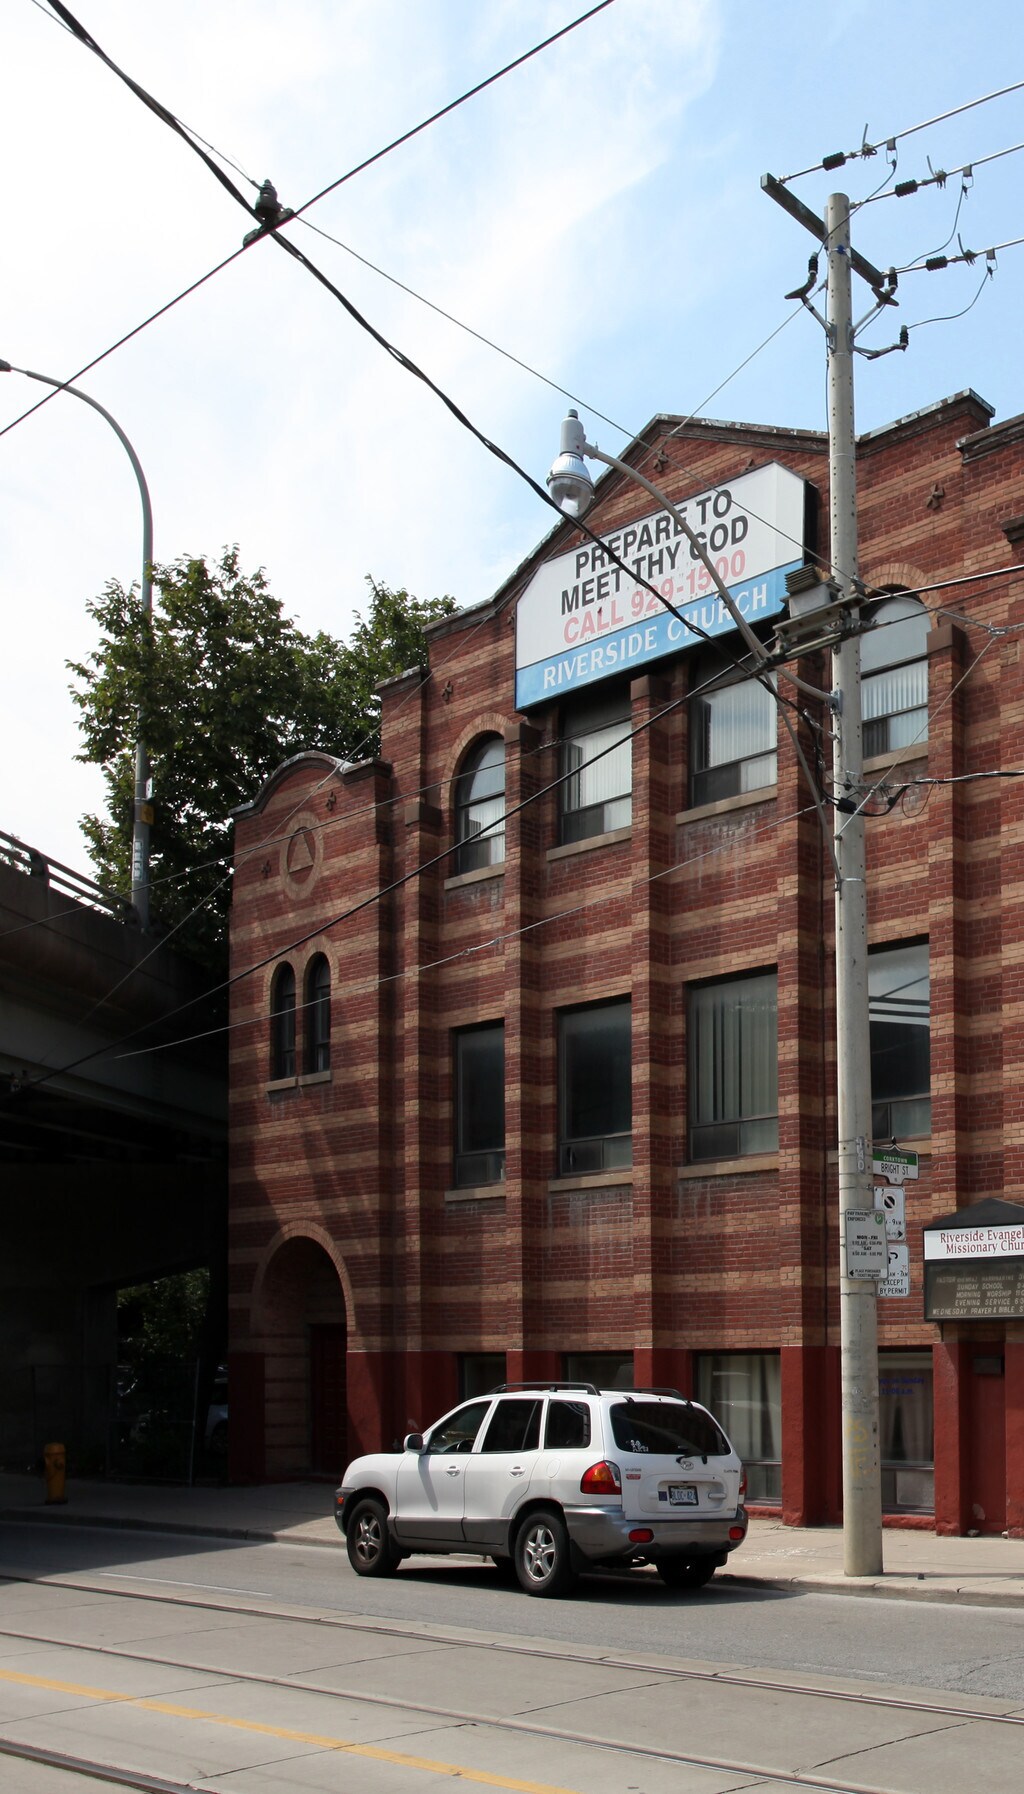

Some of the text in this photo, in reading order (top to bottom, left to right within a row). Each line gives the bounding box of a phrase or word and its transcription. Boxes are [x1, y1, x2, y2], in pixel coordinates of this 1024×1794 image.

[575, 489, 732, 579] PREPARE TO
[561, 515, 749, 616] MEET THY GOD
[564, 549, 746, 644] CALL 929-1500
[543, 583, 767, 690] RIVERSIDE CHURCH
[880, 1163, 900, 1174] BRIGHT
[940, 1229, 984, 1243] Riverside
[946, 1243, 998, 1255] Missionary
[880, 1287, 907, 1296] BY PERMIT
